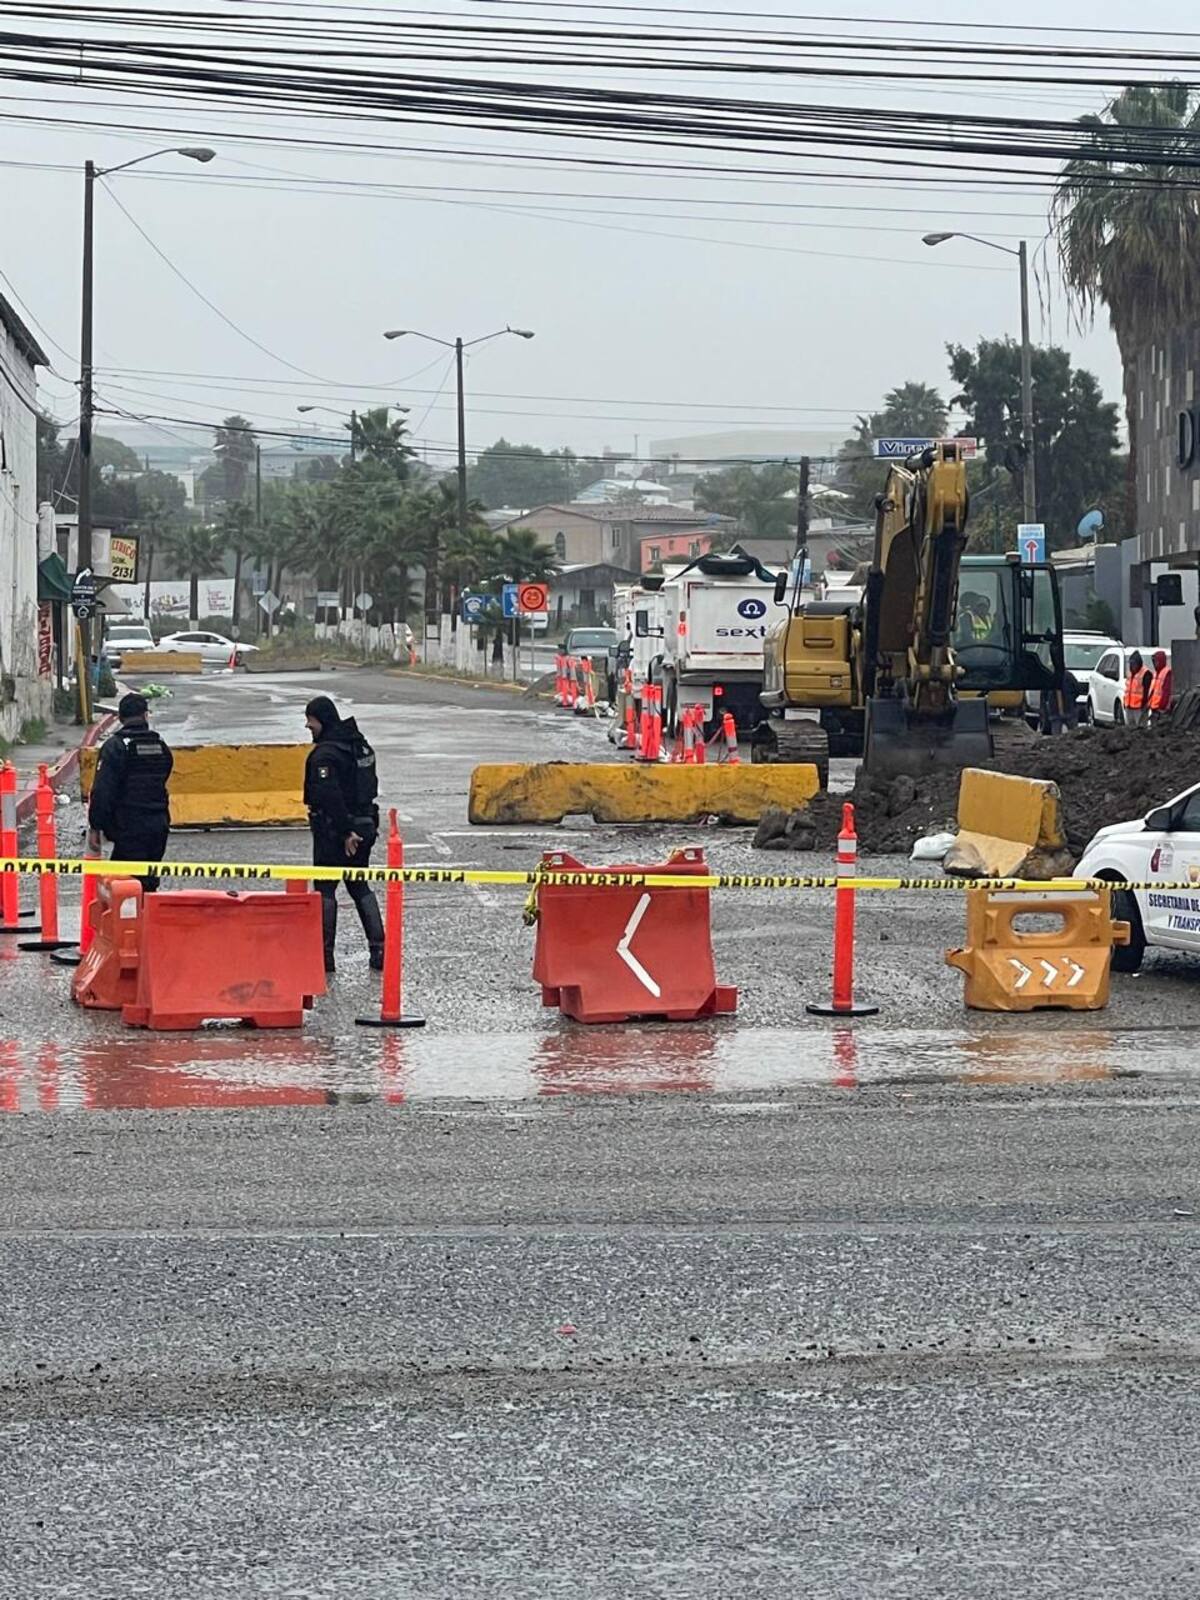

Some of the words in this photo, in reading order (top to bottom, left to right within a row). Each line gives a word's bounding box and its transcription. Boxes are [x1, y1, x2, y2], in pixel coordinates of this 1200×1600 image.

[112, 566, 134, 578] 2131
[1149, 892, 1190, 911] SECRETARIA
[1173, 914, 1200, 932] TRANSP
